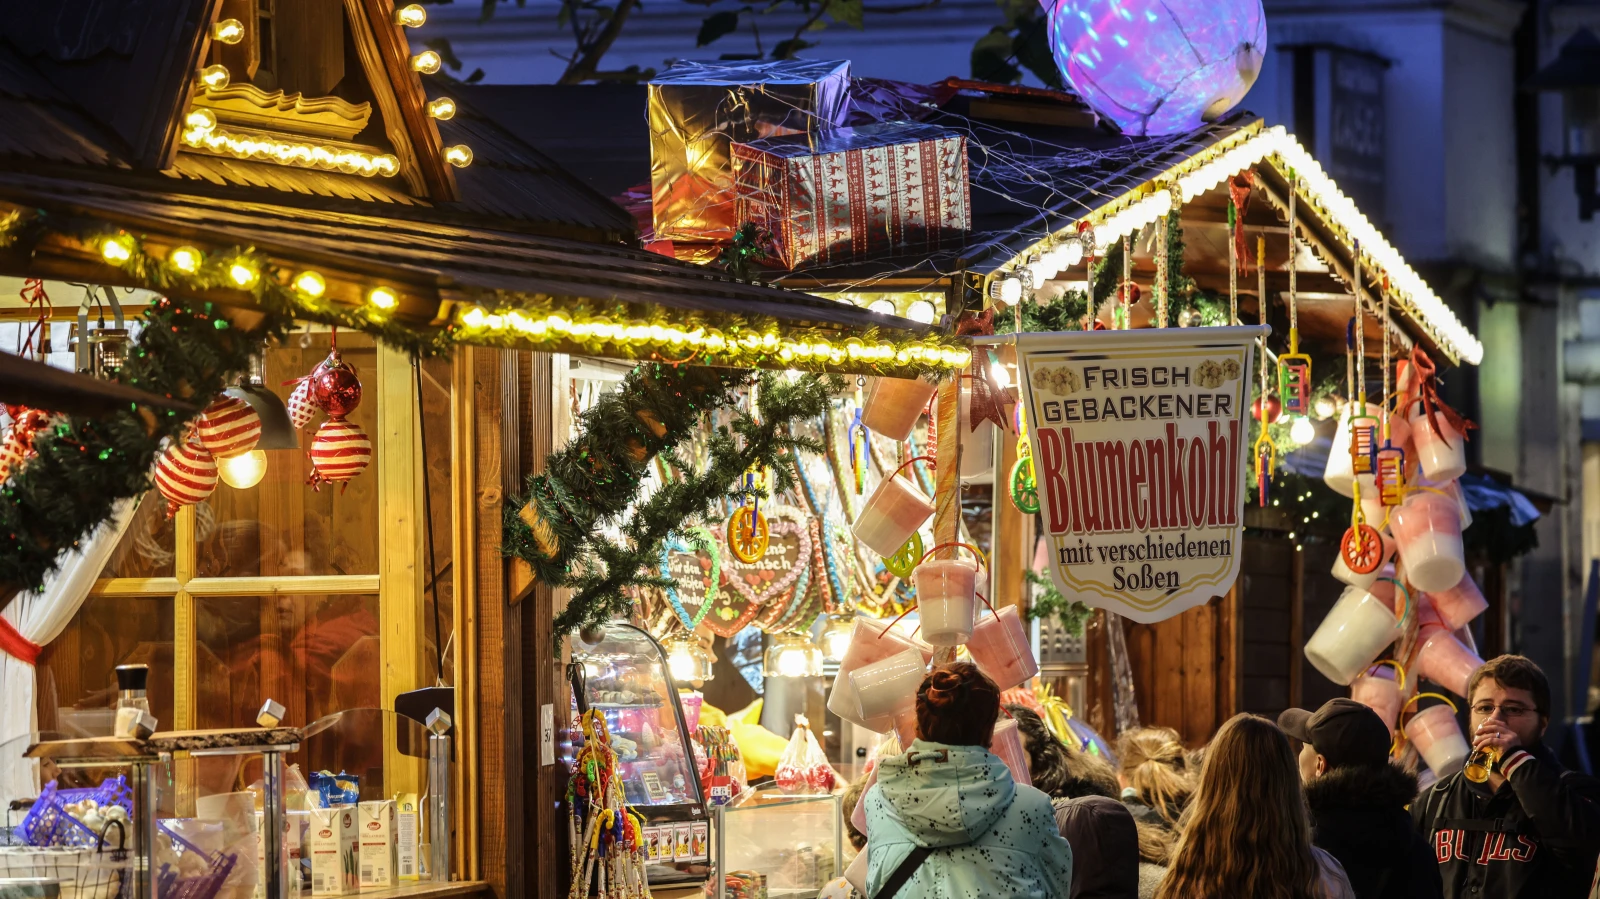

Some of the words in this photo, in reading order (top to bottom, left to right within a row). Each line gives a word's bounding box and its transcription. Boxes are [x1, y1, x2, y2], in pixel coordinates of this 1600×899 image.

[1083, 366, 1191, 389] FRISCH
[1043, 394, 1232, 422] GEBACKENER
[1037, 420, 1240, 534] Blumenkohl
[1060, 539, 1094, 565] mit
[1097, 534, 1232, 562] verschiedenen
[1113, 565, 1181, 591] Soßen
